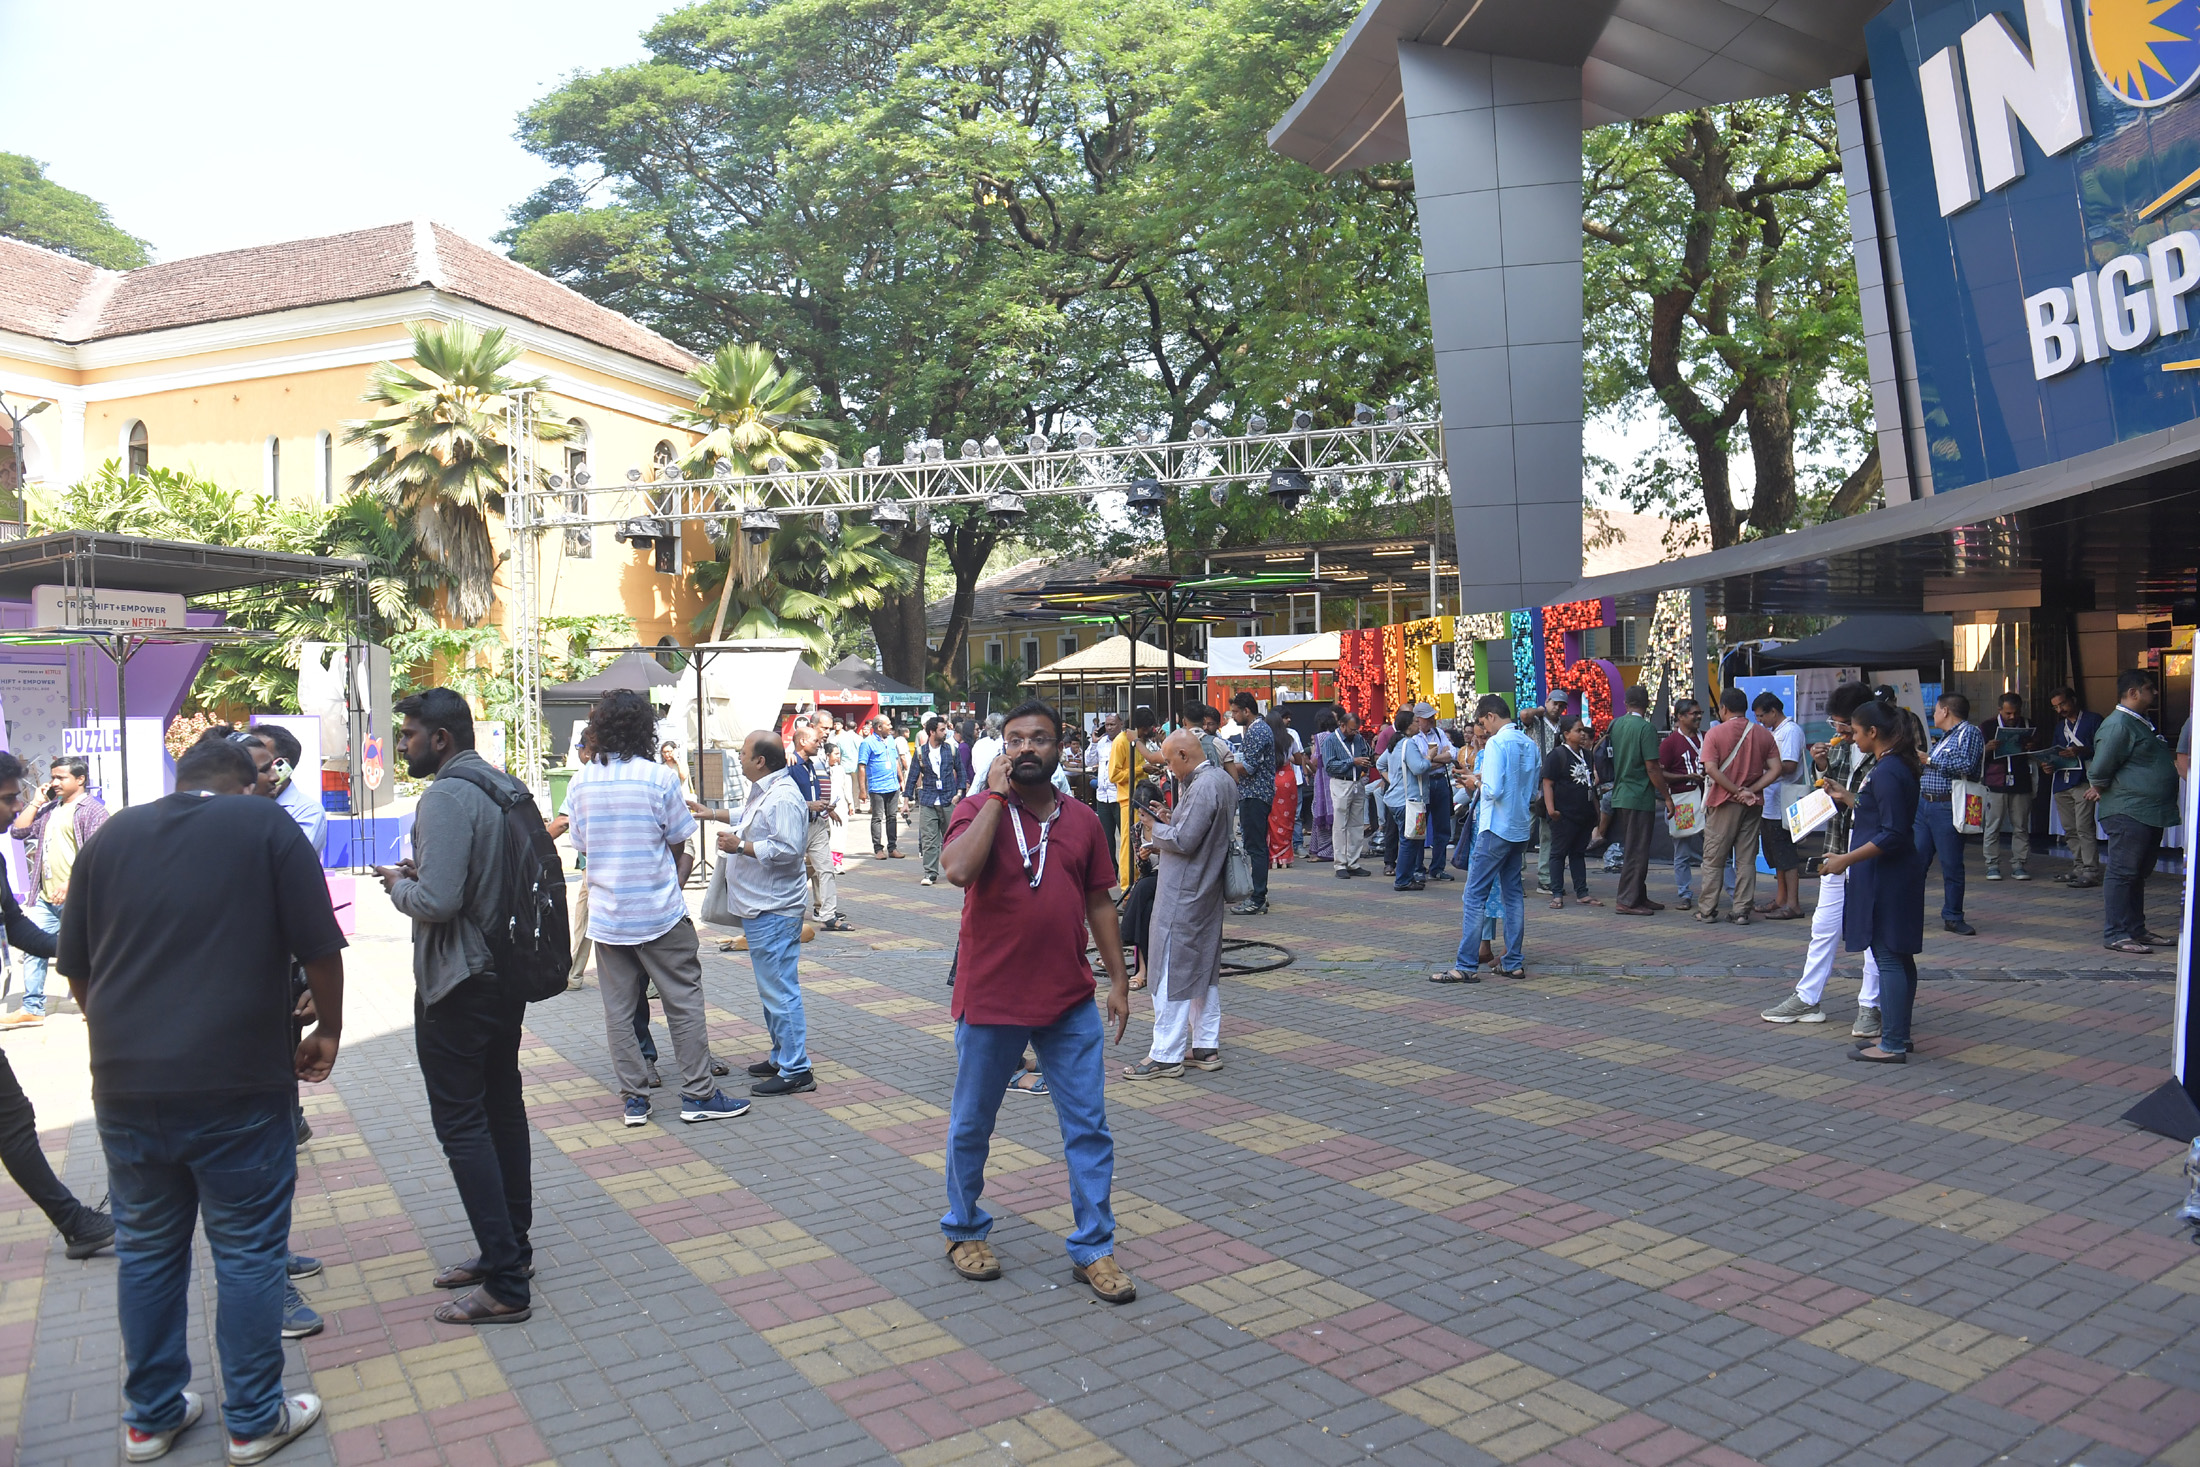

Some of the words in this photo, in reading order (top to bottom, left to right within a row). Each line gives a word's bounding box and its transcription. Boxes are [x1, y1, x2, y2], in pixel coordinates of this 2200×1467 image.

[57, 601, 166, 613] CR+SHIFT+EMPOWER
[132, 618, 167, 627] NETFLIX
[64, 729, 121, 754] PUZZLE
